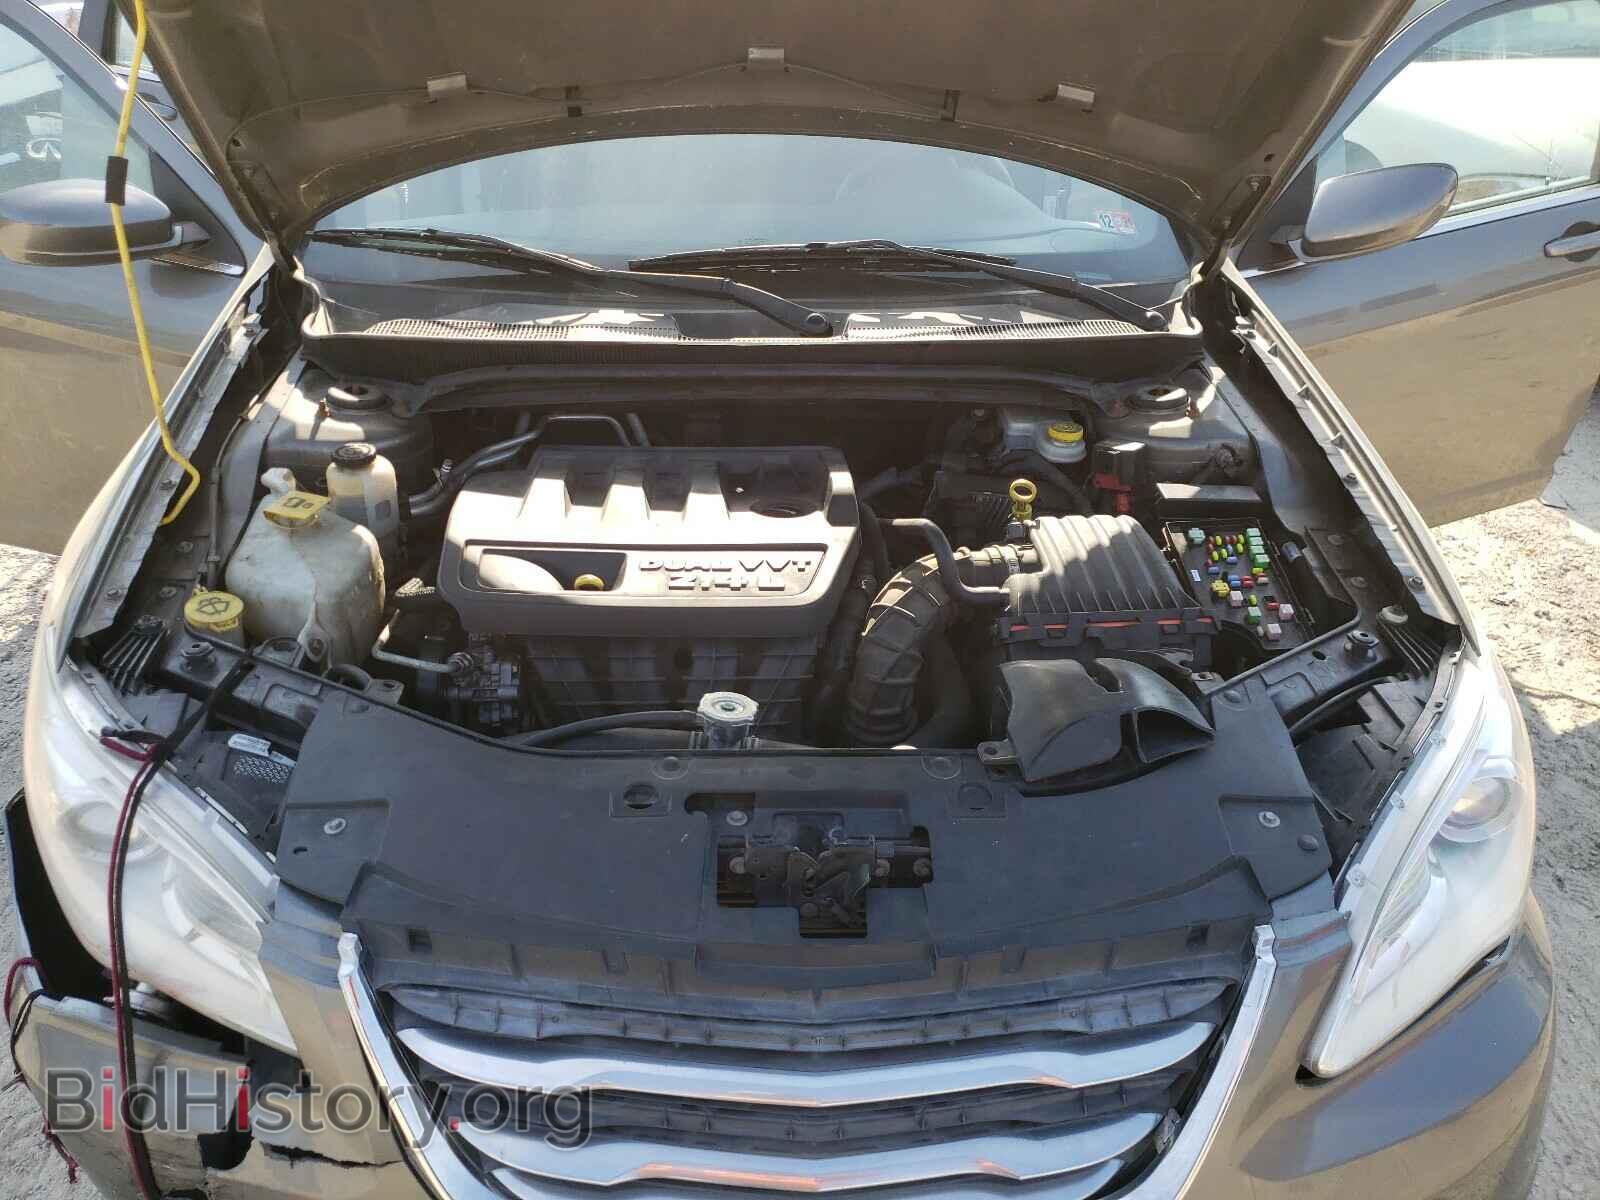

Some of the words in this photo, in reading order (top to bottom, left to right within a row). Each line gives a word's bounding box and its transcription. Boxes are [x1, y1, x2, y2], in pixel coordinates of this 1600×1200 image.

[1098, 213, 1114, 229] 12
[639, 559, 733, 572] DUAL
[739, 559, 812, 572] VVT
[668, 575, 786, 591] 2.4L
